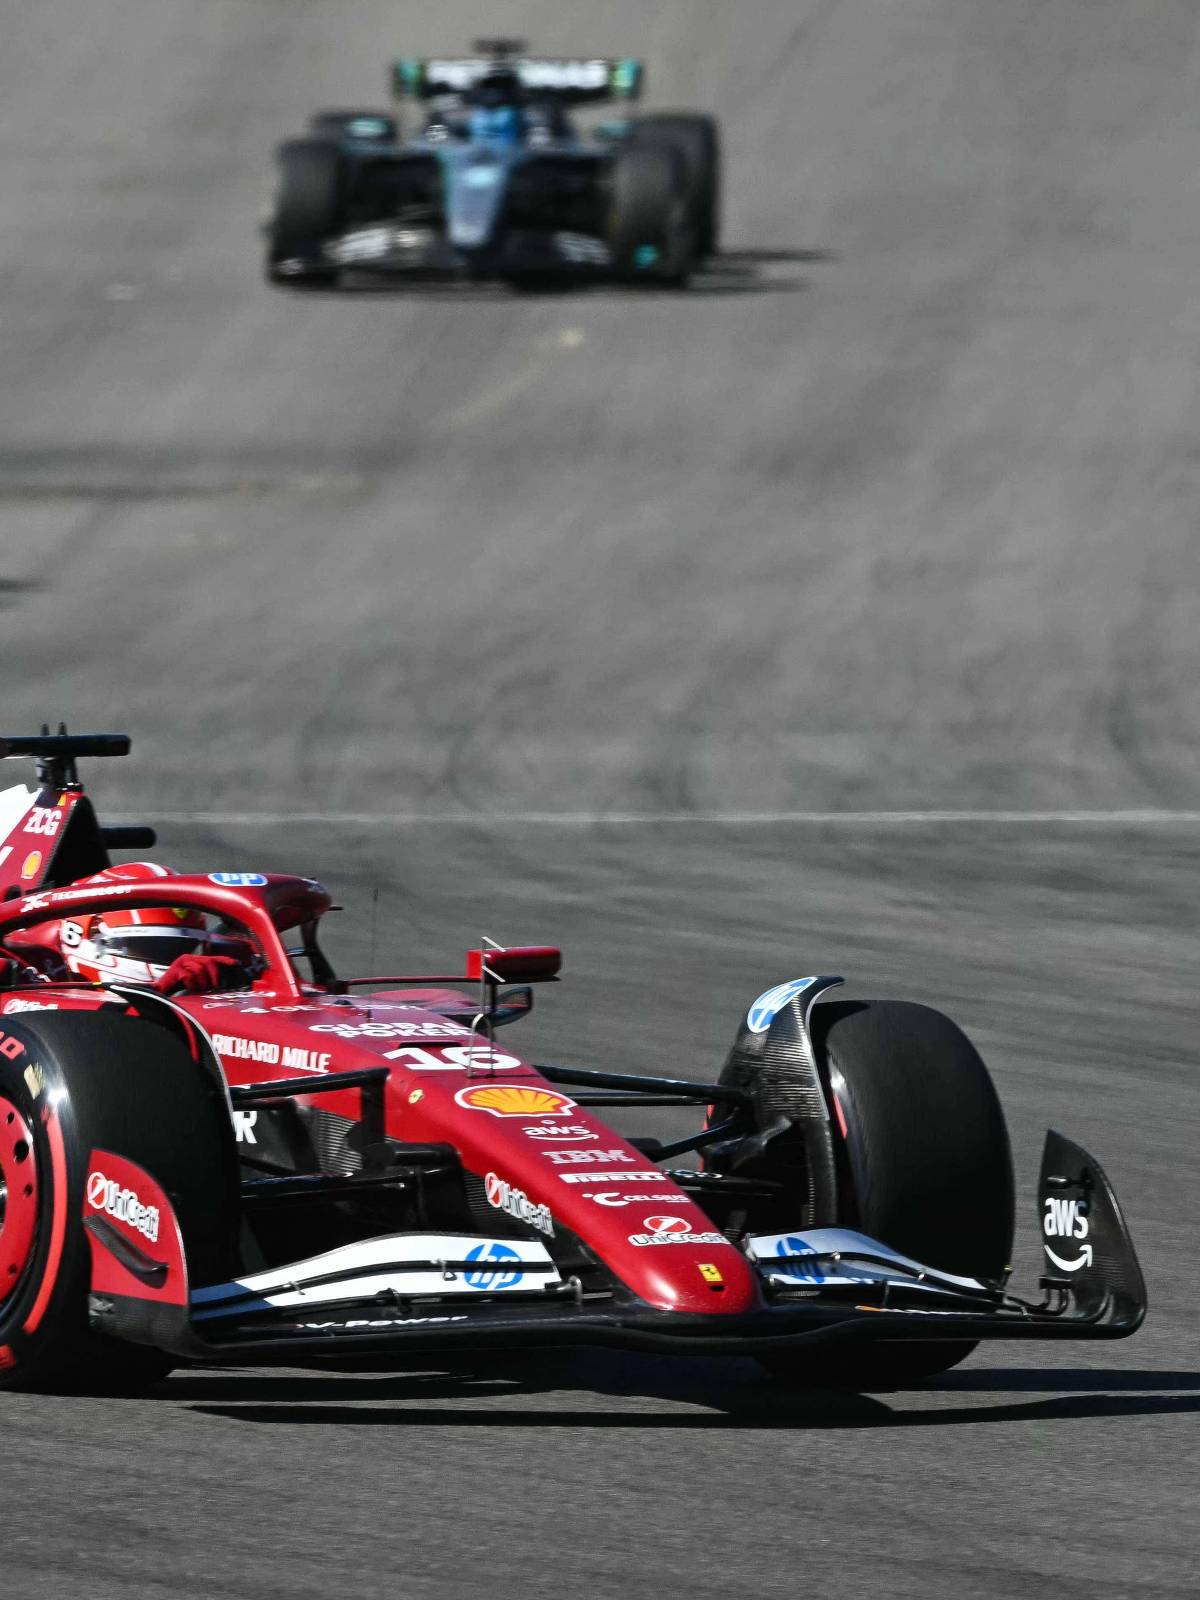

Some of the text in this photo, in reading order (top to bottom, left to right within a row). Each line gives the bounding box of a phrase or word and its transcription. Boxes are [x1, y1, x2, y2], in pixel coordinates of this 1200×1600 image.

[308, 1022, 473, 1032] GLOBAL
[212, 1034, 332, 1073] RICHARD MILLE
[382, 1046, 521, 1070] 16
[522, 1125, 593, 1137] aws
[542, 1150, 636, 1164] IBM
[559, 1171, 667, 1183] PIRELLI
[1044, 1197, 1089, 1240] aws
